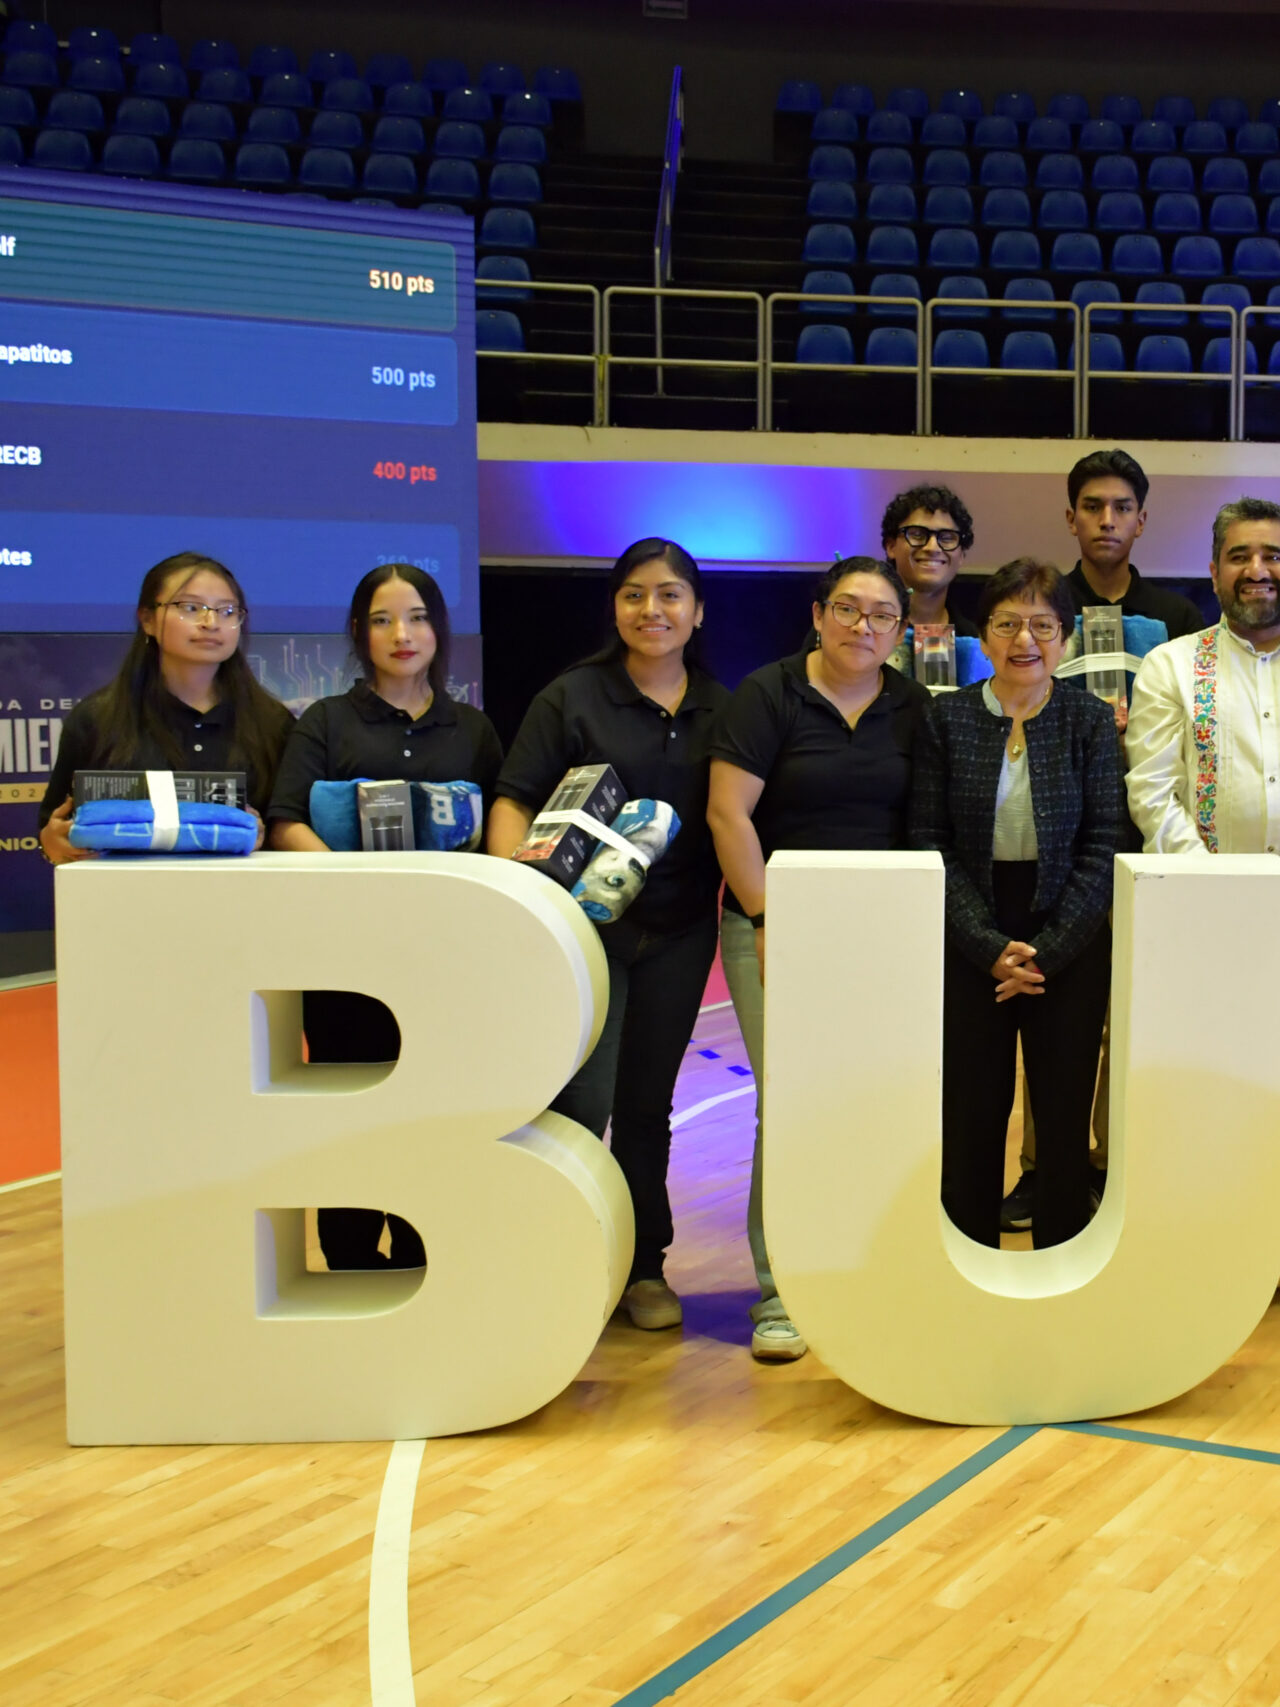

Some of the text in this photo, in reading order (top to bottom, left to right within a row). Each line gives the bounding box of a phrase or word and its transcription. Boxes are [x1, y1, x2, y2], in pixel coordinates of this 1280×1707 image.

[0, 235, 16, 256] lf
[369, 269, 435, 296] 510 pts
[372, 366, 437, 391] 500 pts
[0, 445, 42, 465] ECB
[373, 461, 437, 485] 400 pts
[0, 548, 32, 566] tes
[0, 698, 82, 711] A DE
